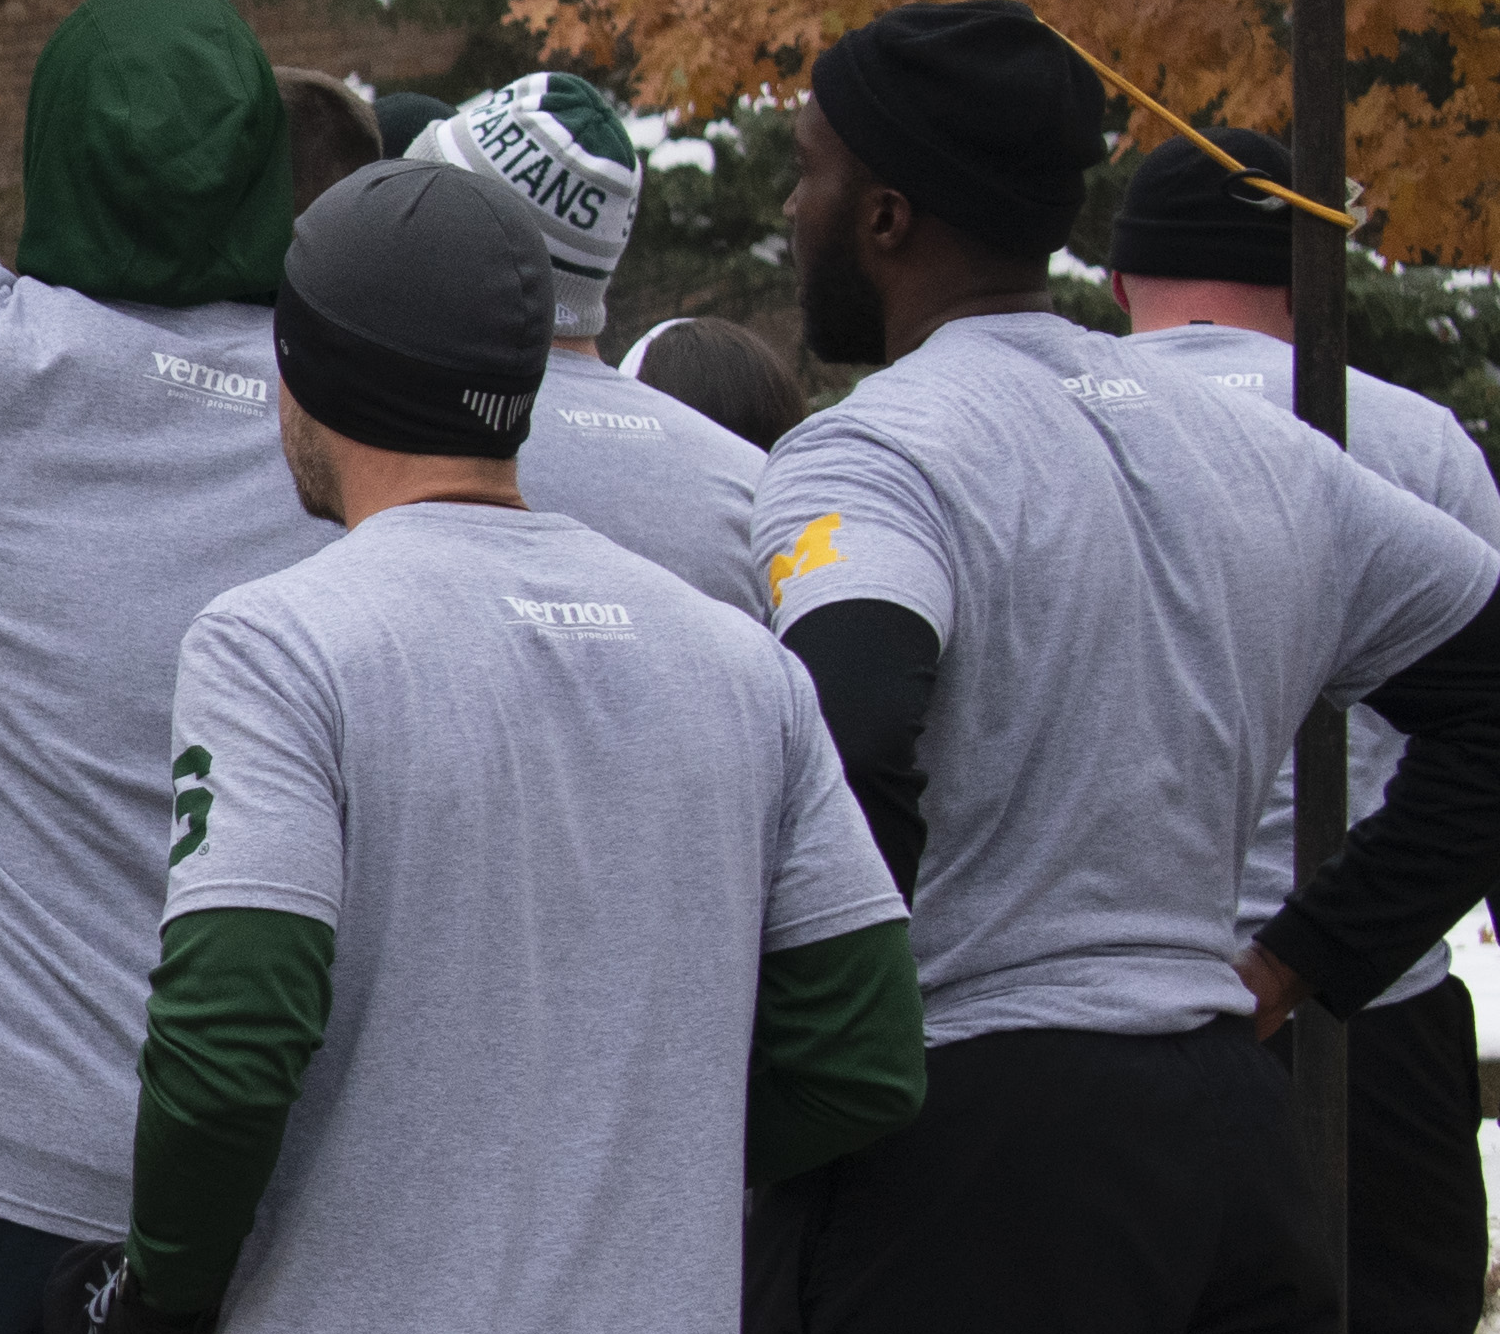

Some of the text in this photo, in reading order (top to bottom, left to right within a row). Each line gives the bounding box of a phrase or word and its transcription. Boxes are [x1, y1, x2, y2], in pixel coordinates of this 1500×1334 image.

[151, 352, 268, 403] vernon
[555, 408, 663, 431] vernon
[501, 596, 633, 625] vernon
